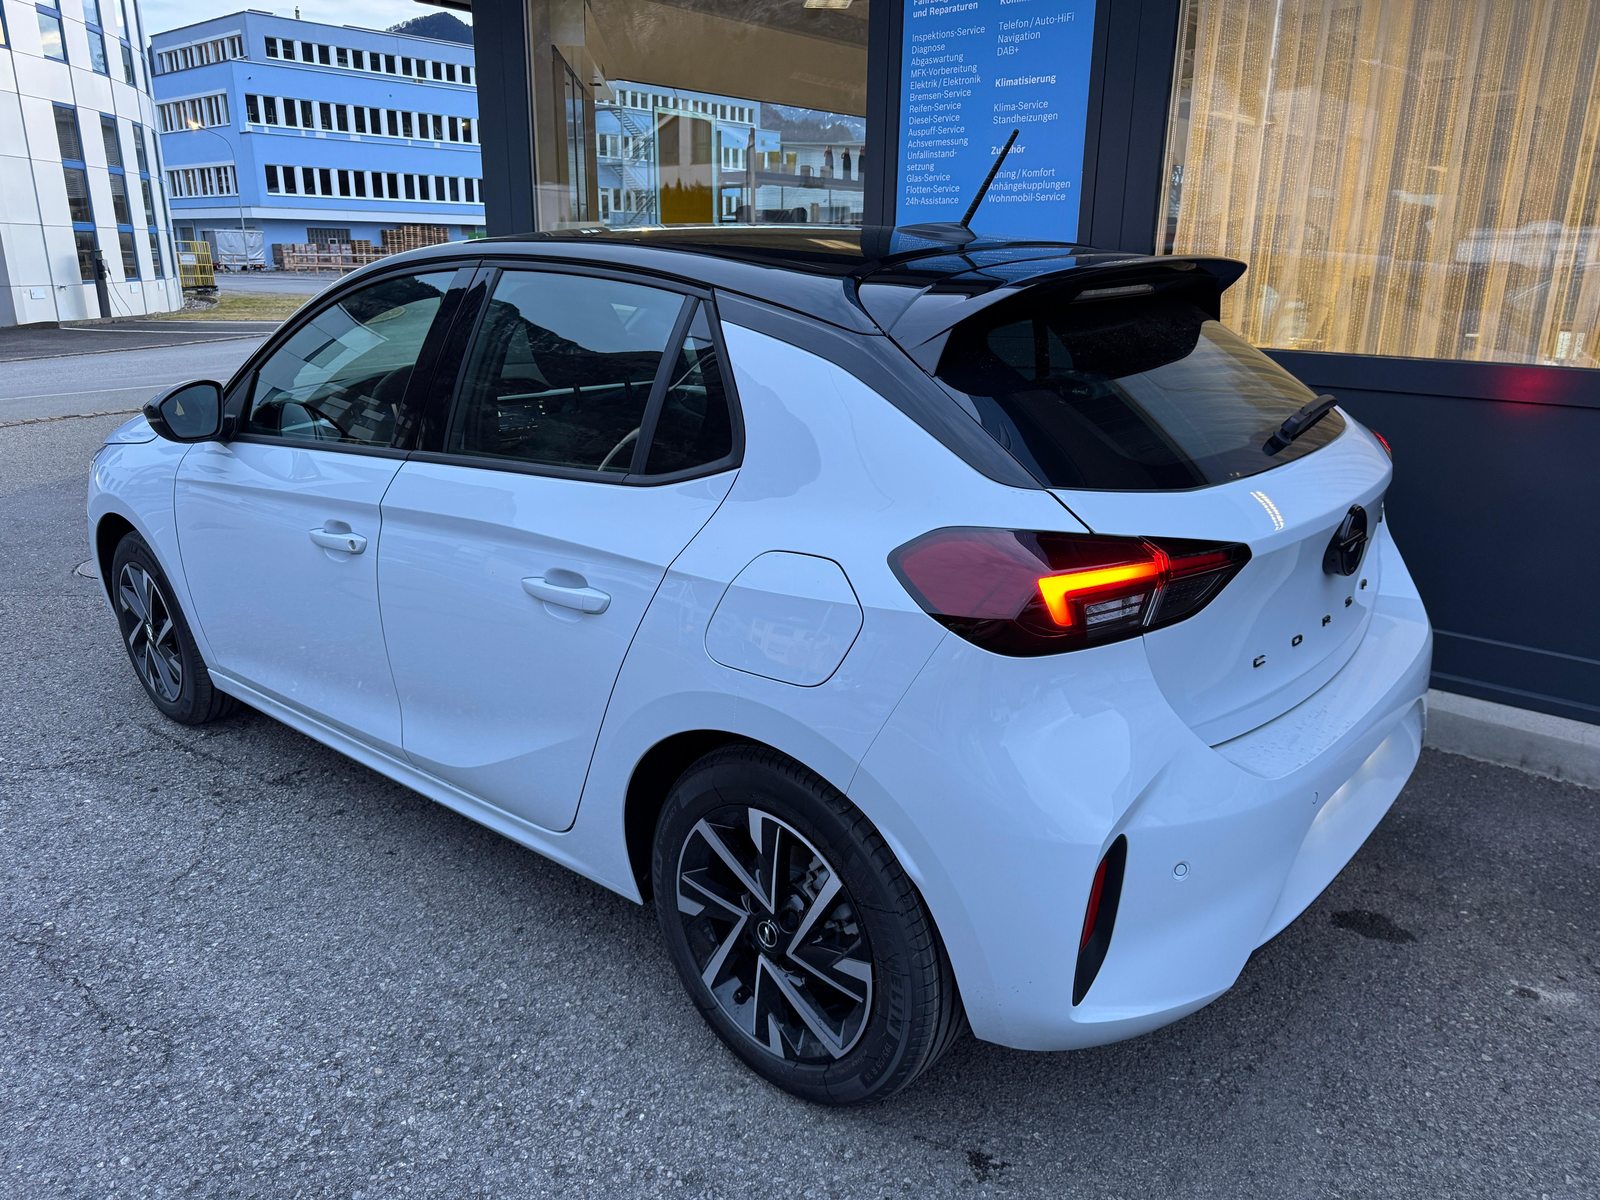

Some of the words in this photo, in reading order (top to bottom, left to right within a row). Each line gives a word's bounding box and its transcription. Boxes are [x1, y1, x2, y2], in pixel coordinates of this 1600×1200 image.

[913, 7, 927, 18] und
[930, 2, 978, 16] Reparaturen
[912, 26, 986, 42] Inspektions-Service
[998, 31, 1041, 43] Navigation
[911, 44, 946, 54] Diagnose
[997, 46, 1019, 56] DAB+
[911, 54, 964, 67] Abgaswartung
[910, 65, 977, 78] MFK-Vorbereitung
[995, 75, 1056, 87] Klimatisierung
[910, 89, 972, 102] Bremsen-Service
[909, 102, 961, 113] Reifen-Service
[993, 100, 1049, 112] Klima-Service
[908, 114, 960, 125] Diesel-Service
[993, 113, 1058, 124] Standheizungen
[908, 125, 965, 137] Auspuff-Service
[908, 138, 969, 148] Achsvermessung
[907, 163, 935, 171] setzung
[906, 173, 951, 182] Glas-Service
[906, 184, 960, 194] Flotten-Service
[988, 180, 1071, 191] Anhängekupplungen
[905, 196, 960, 206] 24h-Assistance
[988, 193, 1066, 203] Wohnmobil-Service
